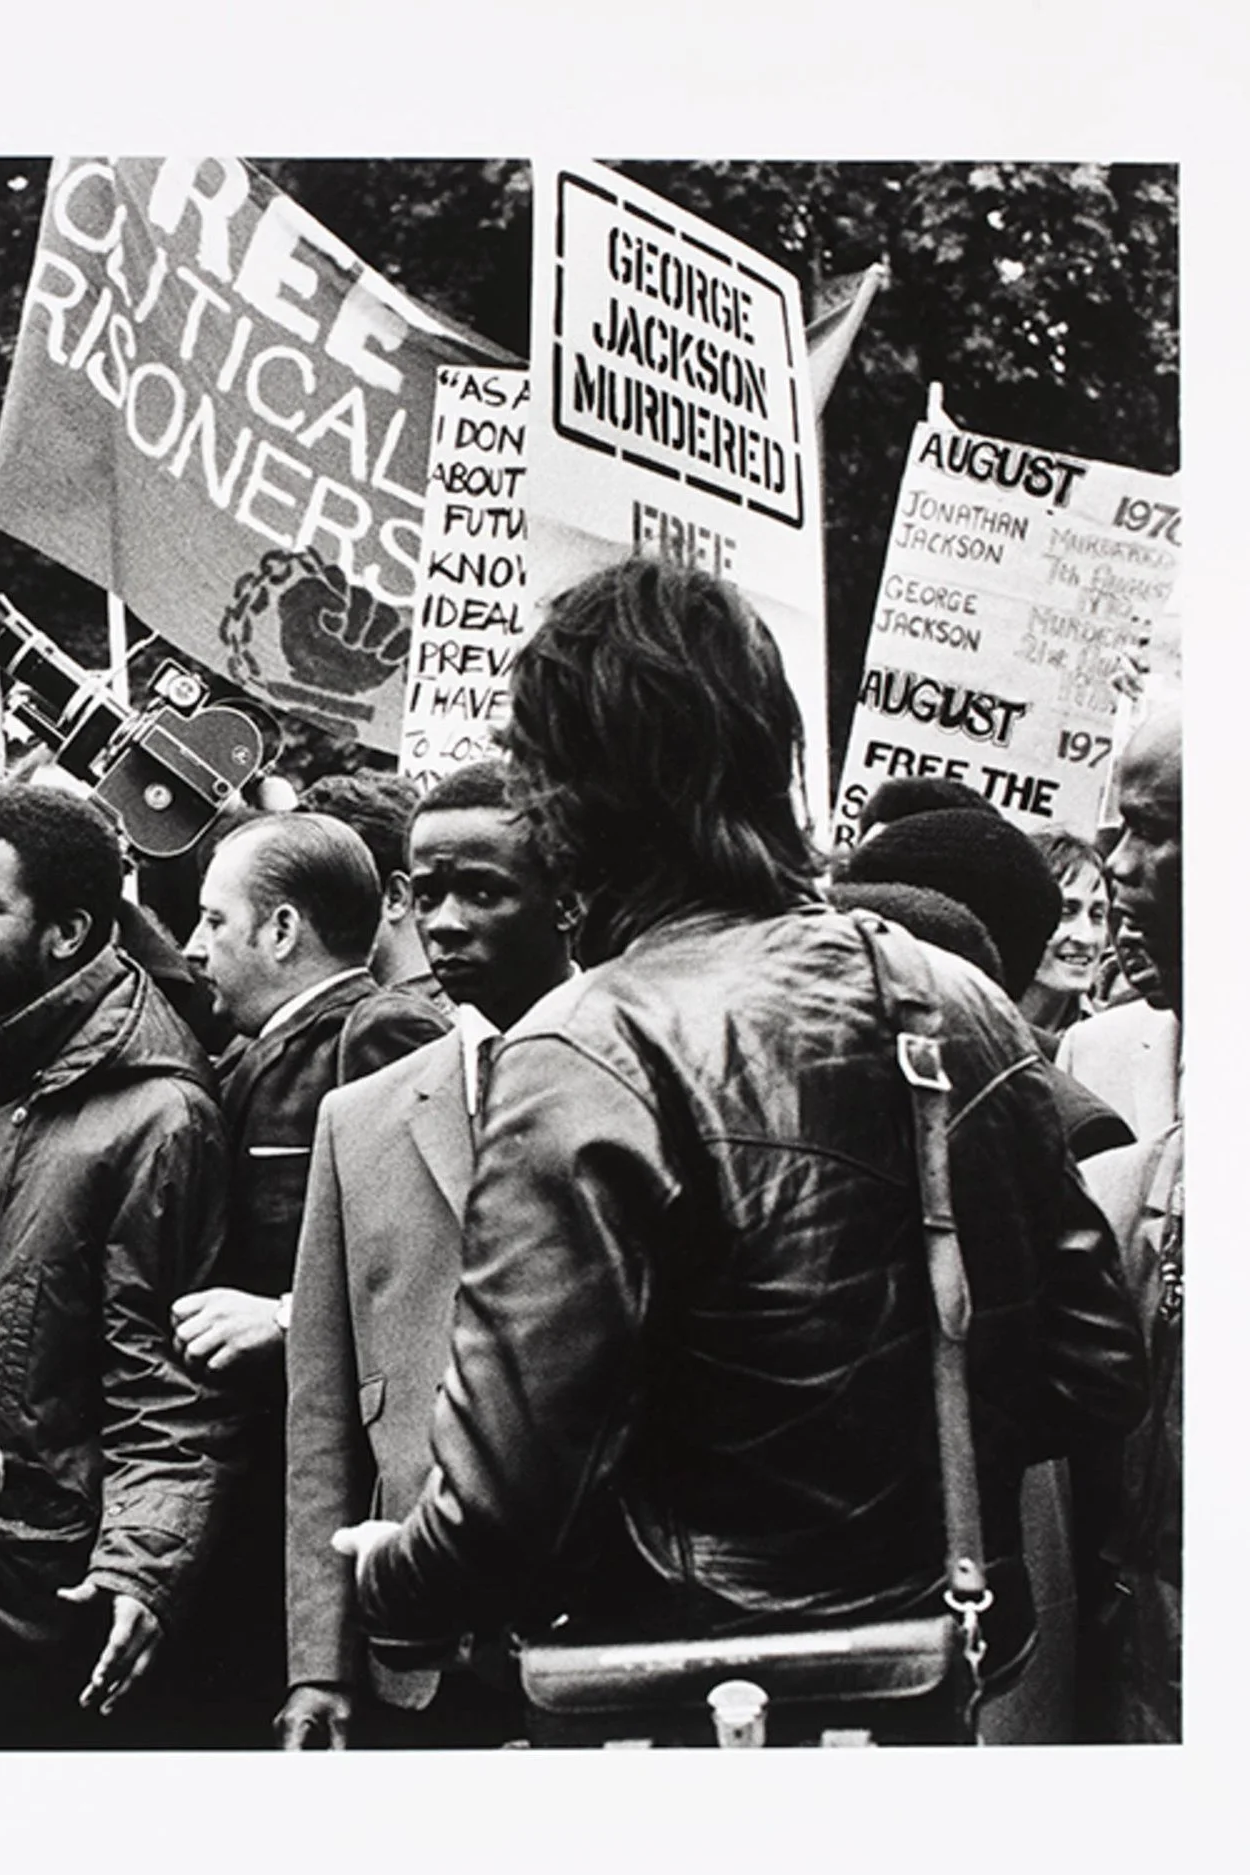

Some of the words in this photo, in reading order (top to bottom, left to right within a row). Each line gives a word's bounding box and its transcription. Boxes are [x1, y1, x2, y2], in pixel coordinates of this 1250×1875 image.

[609, 226, 755, 346] GEORGE
[592, 297, 768, 420] JACKSON
[436, 415, 445, 444] I
[454, 416, 526, 456] DON
[573, 353, 786, 494] MURDERED
[430, 461, 527, 498] ABOUT
[918, 432, 1086, 509] AUGUST
[632, 500, 737, 578] FREE
[901, 489, 1029, 541] JONATHAN
[895, 523, 1004, 565] JACKSON
[422, 593, 524, 634] IDEAL
[884, 573, 979, 616] GEORGE
[877, 608, 982, 652] JACKSON
[430, 685, 510, 720] HAVE
[859, 668, 1027, 747] AUGUST
[863, 741, 970, 778] FREE
[981, 766, 1061, 819] THE
